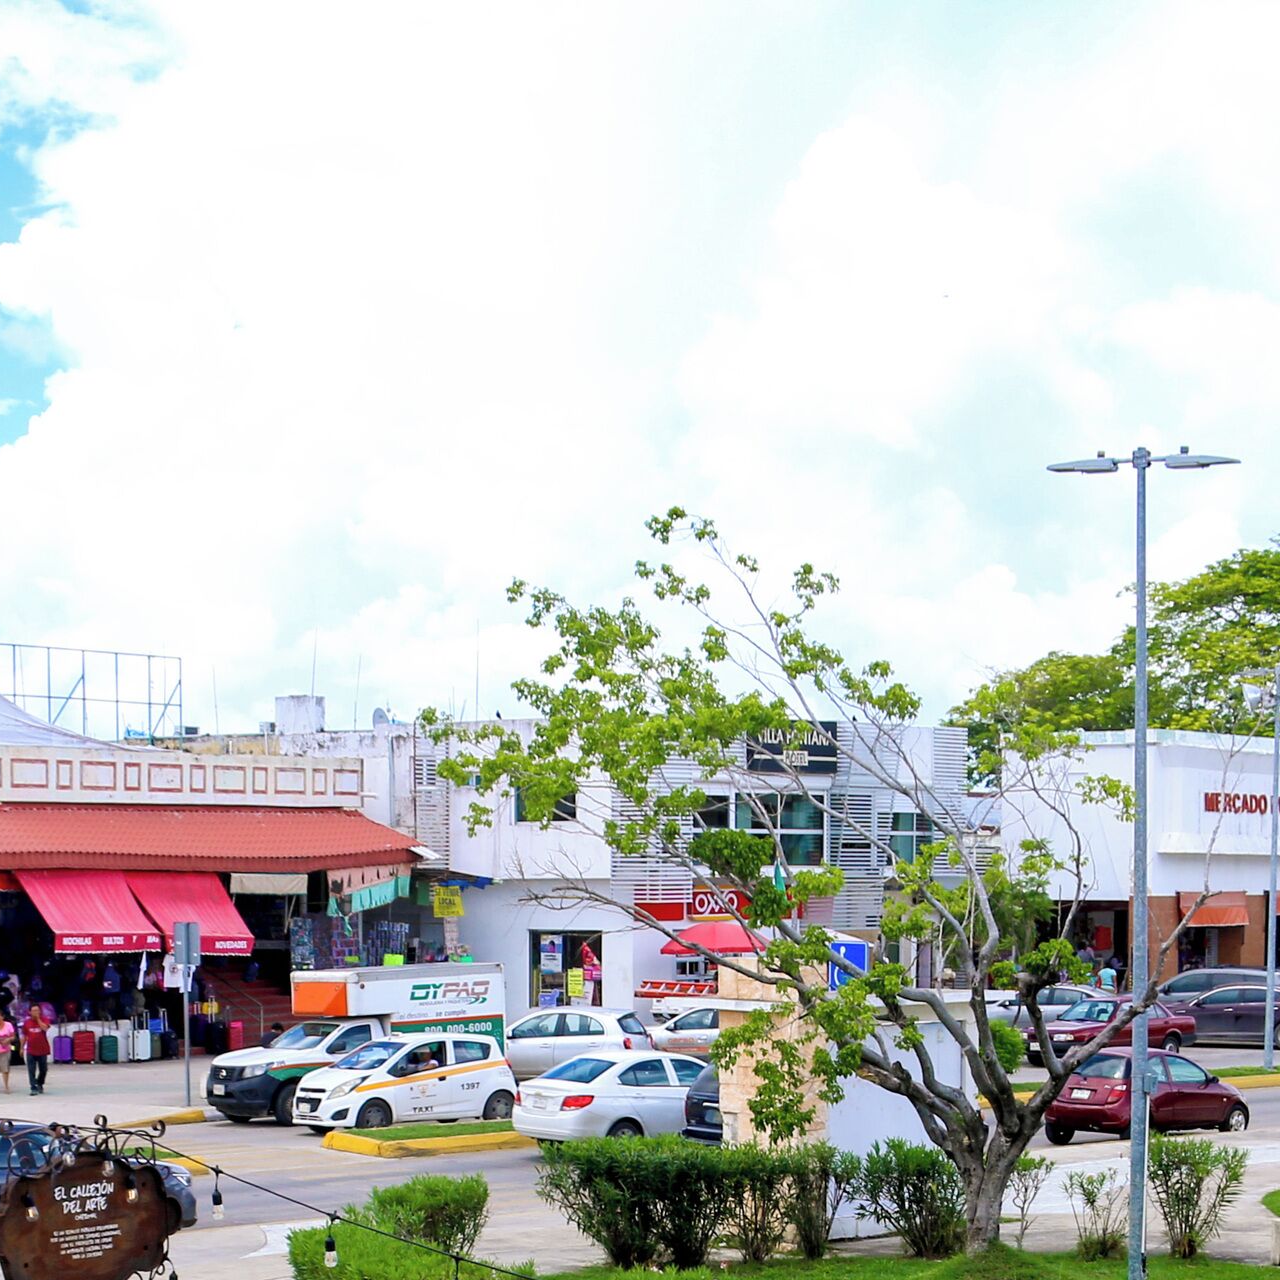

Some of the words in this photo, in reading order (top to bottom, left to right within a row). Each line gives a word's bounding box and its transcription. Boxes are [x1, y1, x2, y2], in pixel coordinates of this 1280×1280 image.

[758, 727, 784, 744] VILLA
[786, 729, 833, 746] FNTANA
[1204, 792, 1268, 815] MERCADO
[695, 892, 738, 914] OXXO
[215, 940, 247, 949] NOVEDADES
[461, 1082, 480, 1090] 1397
[54, 1186, 68, 1201] EL
[70, 1180, 114, 1198] CALLEJÓN
[62, 1200, 82, 1214] DEL
[85, 1196, 108, 1211] ARTE
